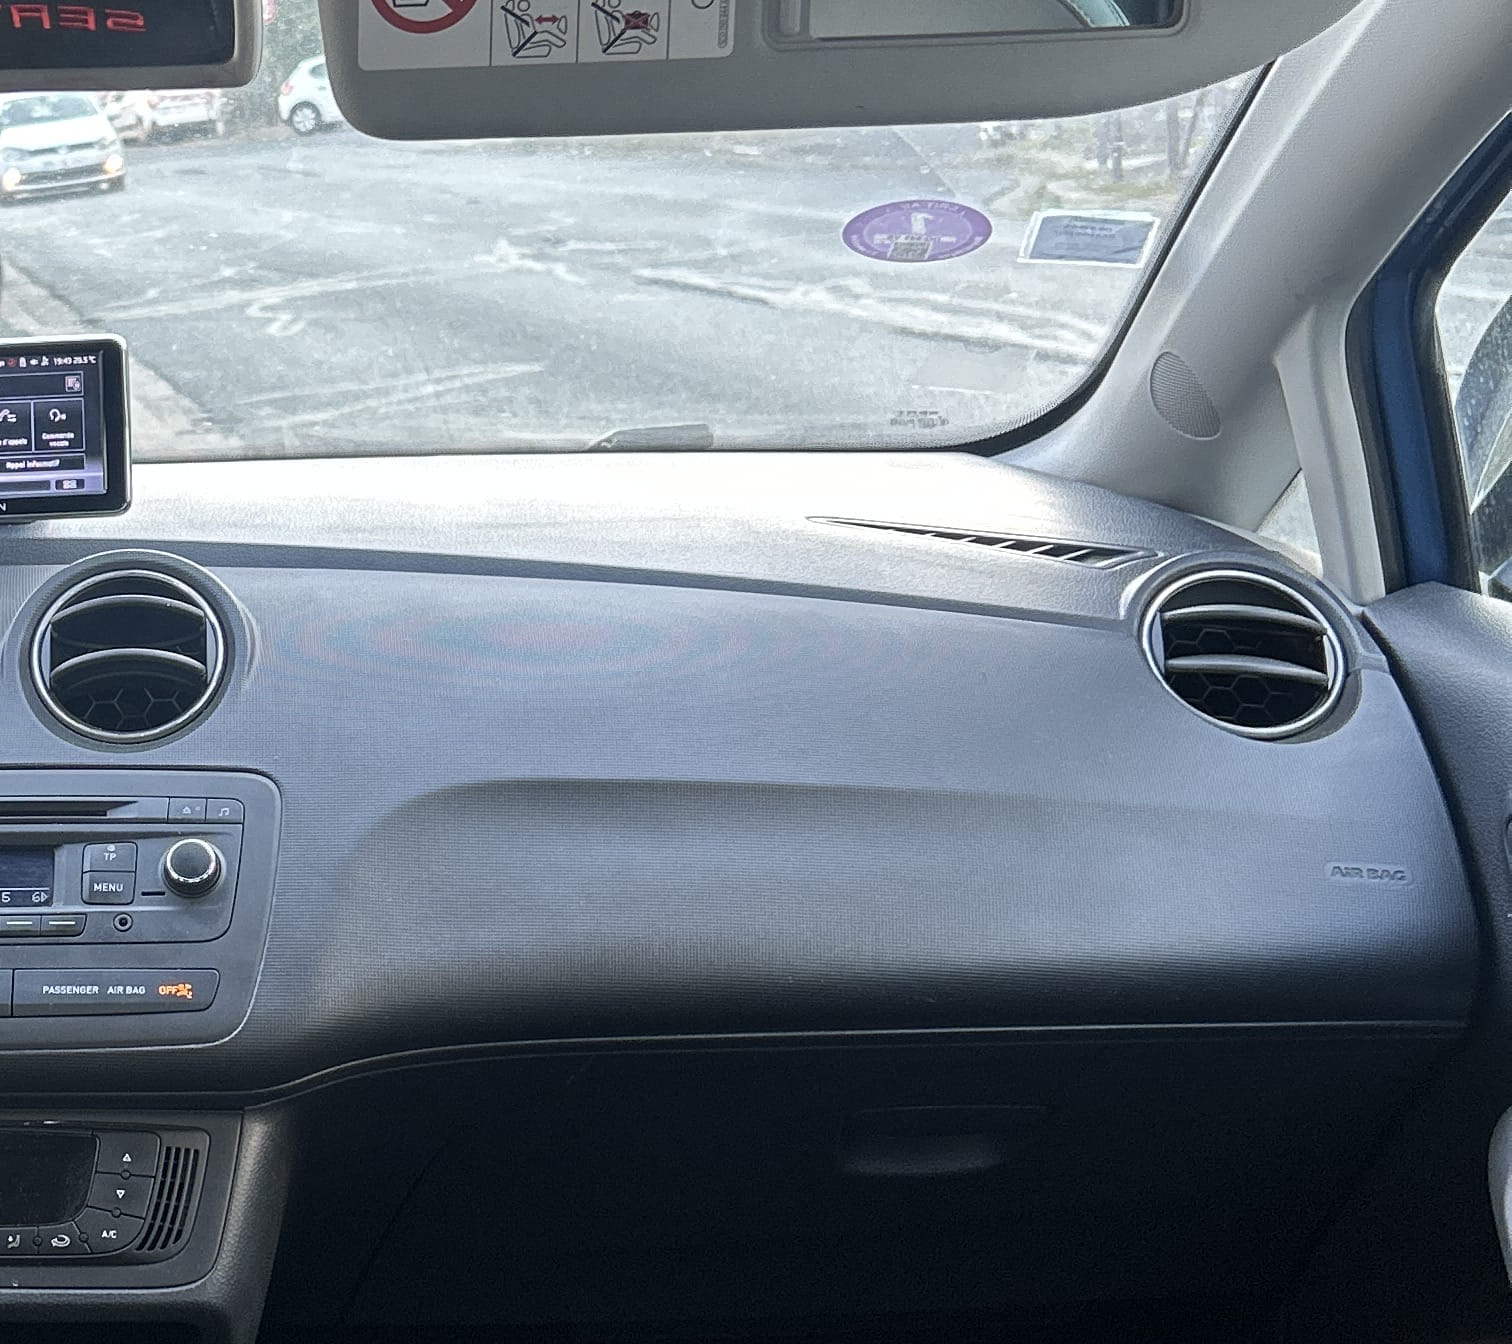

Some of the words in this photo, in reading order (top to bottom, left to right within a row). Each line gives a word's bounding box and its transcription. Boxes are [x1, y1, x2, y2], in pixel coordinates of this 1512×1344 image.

[103, 852, 117, 861] TP
[93, 882, 124, 892] MENU
[1, 891, 11, 903] 5
[31, 891, 41, 902] 6
[42, 985, 99, 995] PASSENGER
[107, 985, 124, 995] AIR
[125, 985, 146, 995] BAG
[158, 984, 178, 995] OFF
[101, 1229, 118, 1240] A/C
